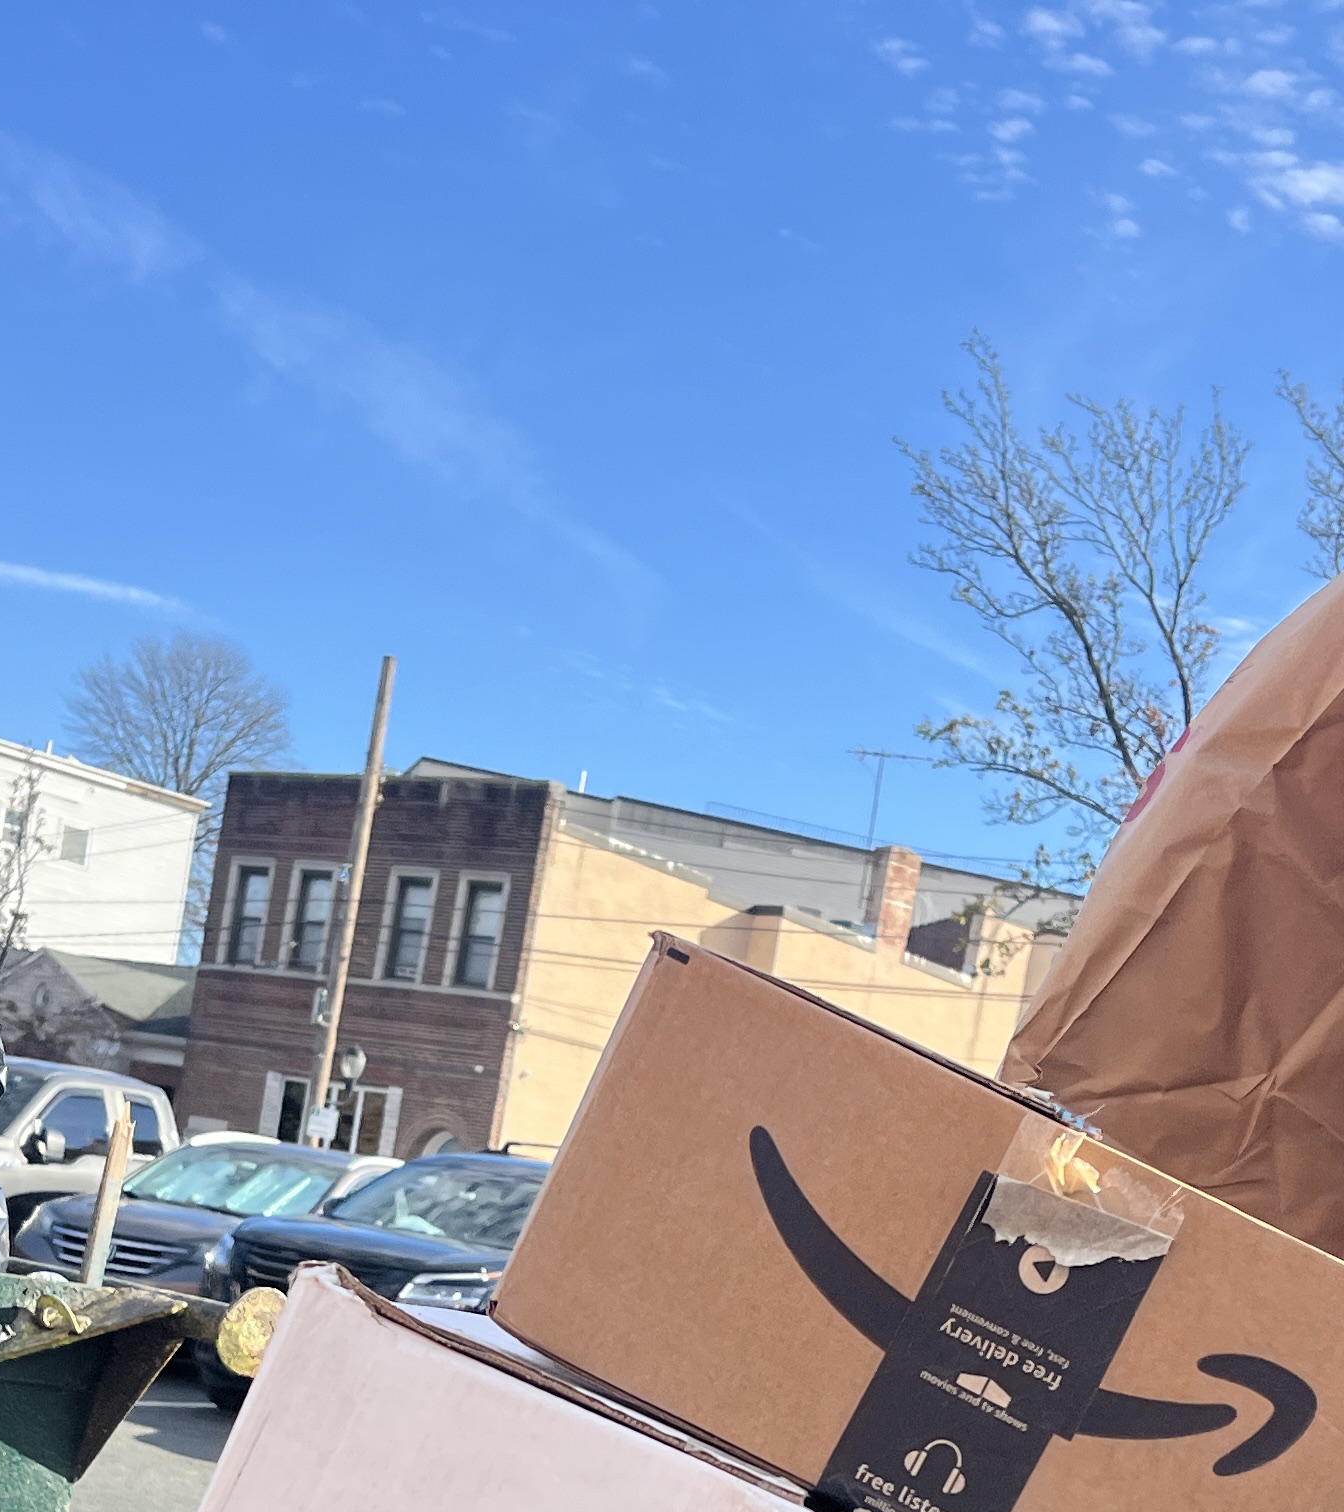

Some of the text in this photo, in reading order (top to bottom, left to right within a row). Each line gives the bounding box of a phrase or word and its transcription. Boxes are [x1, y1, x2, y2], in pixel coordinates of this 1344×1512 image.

[949, 1302, 1010, 1338] convenient
[939, 1317, 1063, 1392] free delivery
[1011, 1333, 1022, 1346] &
[1020, 1338, 1044, 1357] free
[919, 1370, 957, 1396] movies
[957, 1390, 984, 1407] and
[993, 1408, 1029, 1432] shows
[855, 1463, 895, 1496] free
